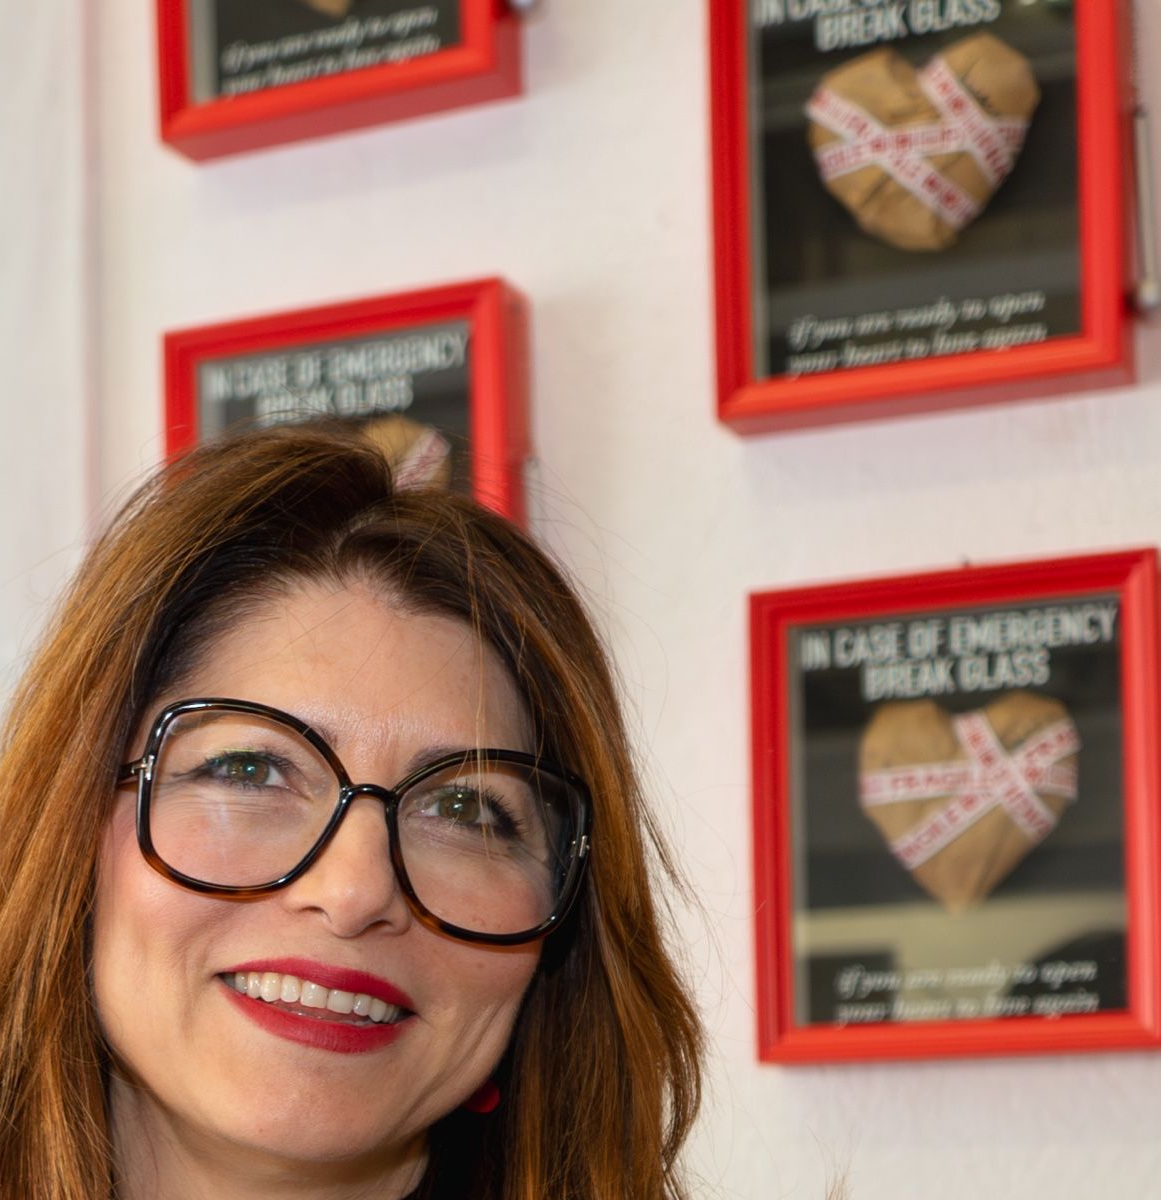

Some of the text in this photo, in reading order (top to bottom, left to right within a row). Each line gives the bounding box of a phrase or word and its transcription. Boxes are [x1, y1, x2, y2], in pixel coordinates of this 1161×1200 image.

[815, 0, 1001, 51] BREAK GLASS
[801, 602, 1118, 671] IN CASE OF EMERGENCY
[862, 648, 1051, 701] BREAK GLASS
[1040, 961, 1098, 990] open
